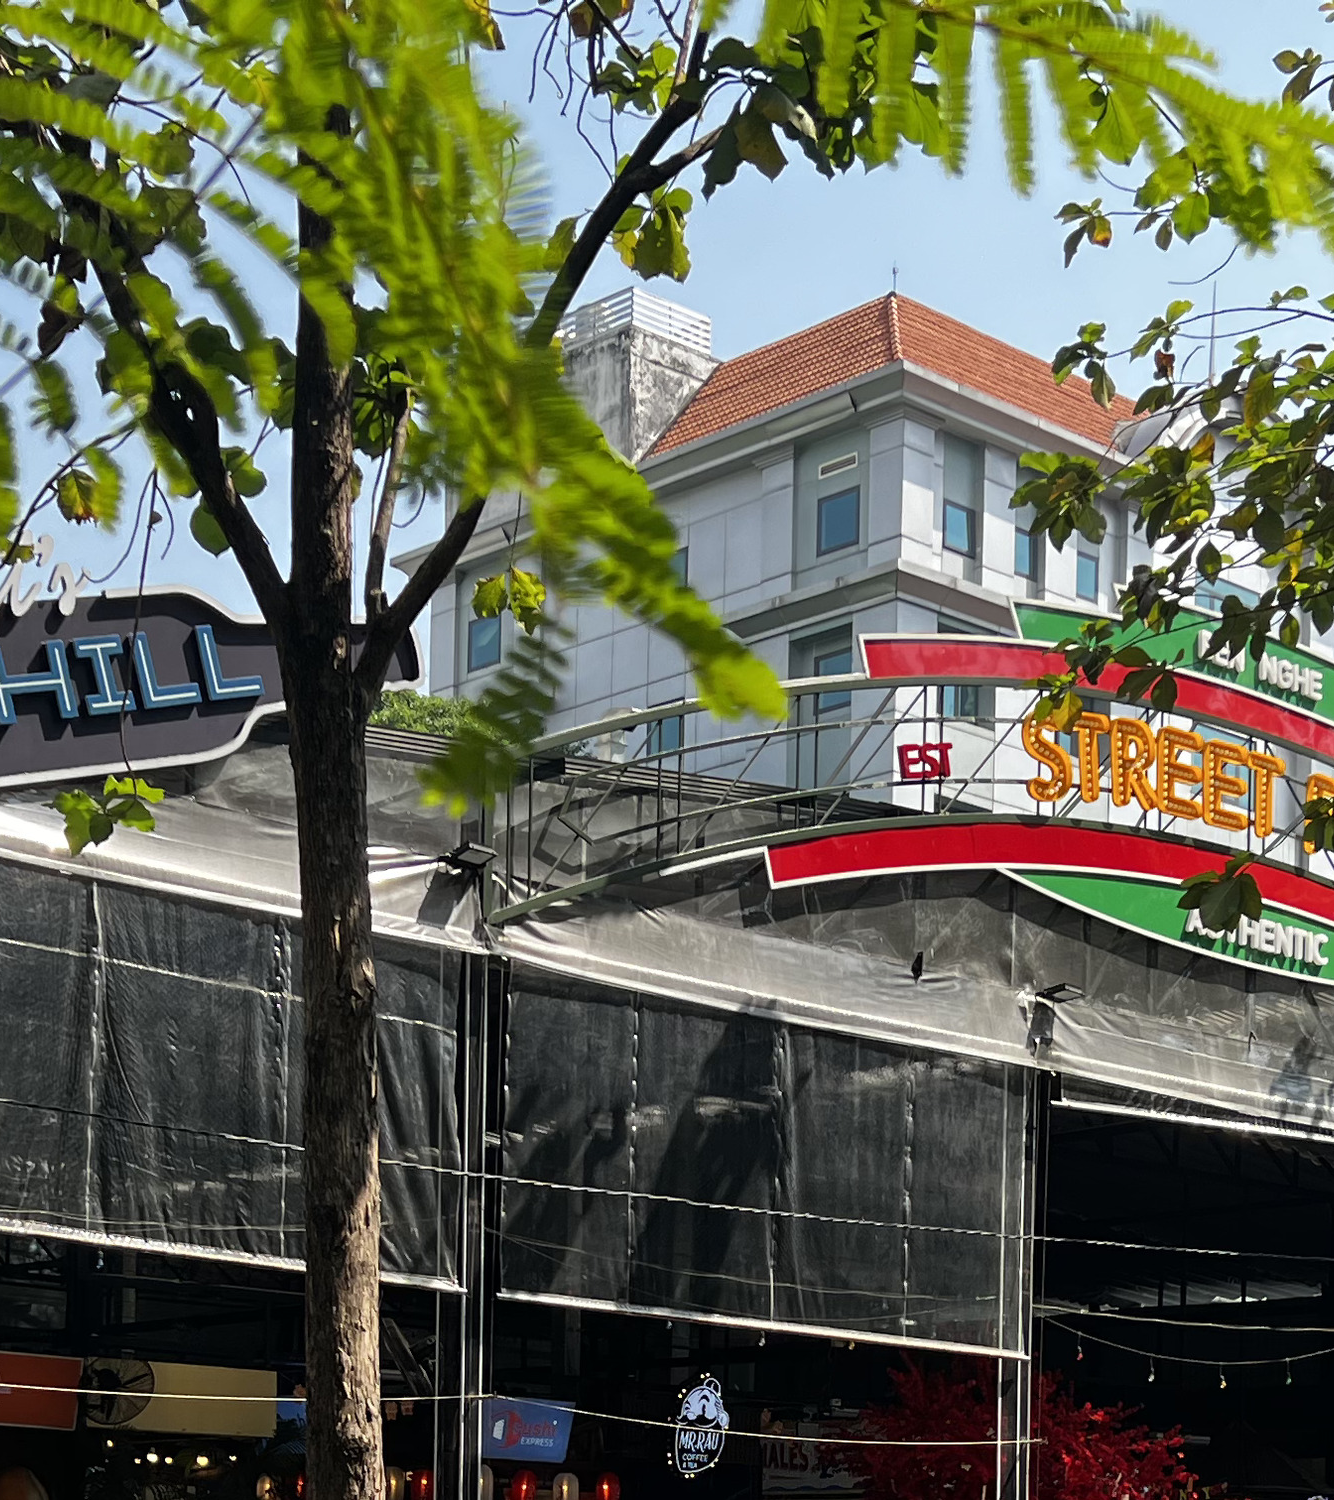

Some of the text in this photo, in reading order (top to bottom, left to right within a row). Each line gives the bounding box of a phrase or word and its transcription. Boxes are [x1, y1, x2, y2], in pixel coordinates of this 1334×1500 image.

[1259, 652, 1323, 700] NGHE
[897, 742, 953, 779] EST
[1022, 711, 1286, 838] STREET
[1185, 908, 1328, 966] AHENTIC
[520, 1437, 554, 1447] EXPRESS
[682, 1453, 709, 1462] COFFEE
